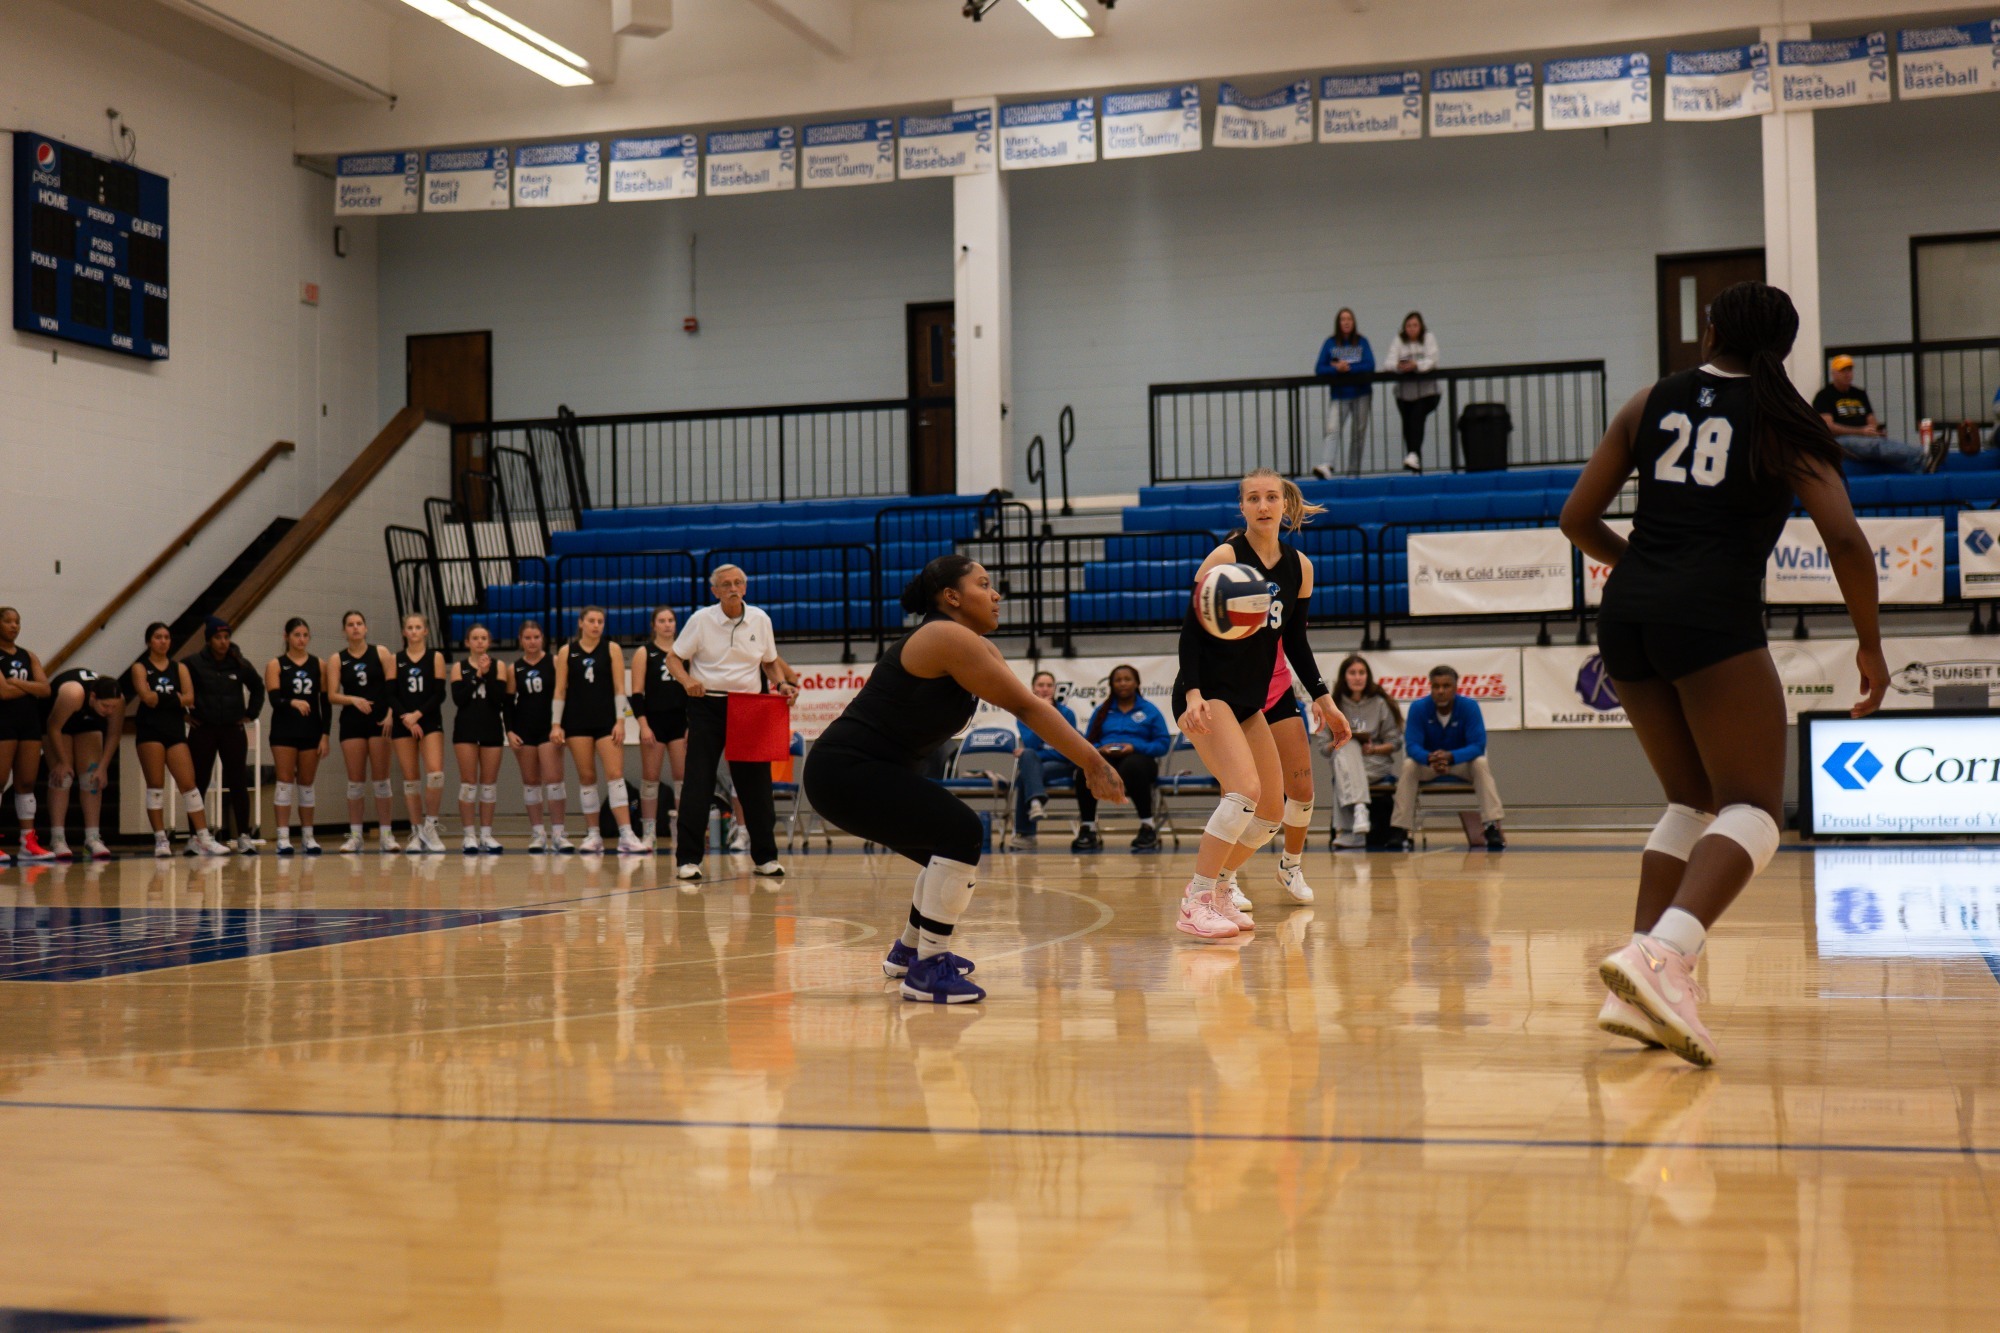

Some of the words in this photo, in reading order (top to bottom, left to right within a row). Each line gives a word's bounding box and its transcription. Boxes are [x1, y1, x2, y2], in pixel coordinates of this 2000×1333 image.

[1866, 32, 1887, 83] 2013
[1630, 52, 1649, 102] 2013
[1750, 42, 1769, 95] 2013
[1903, 62, 1945, 76] Men's
[1441, 69, 1487, 88] SWEET
[1491, 67, 1508, 84] 16
[1514, 62, 1533, 110] 2013
[1783, 75, 1824, 88] Men's
[1903, 67, 1977, 89] Baseball
[1403, 72, 1420, 118] 2013
[1549, 92, 1587, 105] Men's
[1671, 84, 1721, 98] Women's
[1783, 81, 1857, 102] Baseball
[1181, 84, 1198, 131] 2012
[1294, 80, 1311, 126] 2012
[1434, 102, 1472, 113] Men's
[1550, 104, 1579, 119] Track
[1581, 104, 1591, 117] &
[1594, 101, 1621, 117] Field
[1672, 98, 1701, 113] Track
[1704, 98, 1713, 111] &
[1716, 94, 1741, 110] Field
[1077, 97, 1094, 143] 2012
[1221, 113, 1266, 129] Women's
[1324, 109, 1361, 120] Men's
[1434, 109, 1511, 126] Basketball
[976, 109, 992, 154] 2011
[1108, 123, 1144, 135] Men's
[1221, 125, 1248, 140] Track
[1250, 127, 1260, 140] &
[1262, 124, 1286, 139] Field
[1324, 115, 1398, 133] Basketball
[877, 119, 893, 163] 2011
[1005, 135, 1040, 147] Men's
[1108, 135, 1137, 149] Cross
[1138, 131, 1181, 148] Country
[681, 133, 697, 179] 2010
[779, 126, 795, 172] 2010
[904, 145, 939, 158] Men's
[1004, 142, 1067, 160] Baseball
[585, 141, 600, 184] 2006
[807, 152, 849, 165] Women's
[903, 152, 965, 170] Baseball
[404, 152, 418, 196] 2003
[493, 147, 508, 190] 2005
[615, 169, 647, 179] Men's
[711, 163, 743, 175] Men's
[807, 164, 834, 180] Cross
[836, 161, 874, 178] Country
[33, 169, 60, 187] pepsi
[430, 179, 460, 190] Men's
[520, 173, 552, 186] Men's
[615, 177, 672, 193] Baseball
[710, 170, 770, 187] Baseball
[341, 183, 371, 197] Men's
[429, 188, 457, 204] Golf
[519, 183, 548, 199] Golf
[39, 190, 68, 211] HOME
[340, 193, 382, 208] Soccer
[88, 207, 115, 225] PERIOD
[132, 217, 163, 239] GUEST
[92, 237, 113, 253] POSS
[31, 252, 57, 270] FOULS
[89, 250, 116, 268] BONUS
[75, 263, 104, 282] PLAYER
[113, 274, 132, 290] FOUL
[144, 282, 168, 300] FOULS
[40, 317, 59, 332] WON
[111, 334, 133, 349] GAME
[151, 344, 168, 357] WON
[1655, 411, 1733, 487] 28
[1773, 546, 1889, 570] Walt
[1435, 569, 1461, 582] York
[1466, 567, 1493, 580] Cold
[1498, 566, 1545, 581] Storage,
[1548, 566, 1566, 577] LLC
[357, 671, 368, 687] 3
[584, 667, 595, 684] 4
[796, 669, 865, 690] aterin
[1378, 672, 1504, 687] PENR'S
[1932, 666, 1991, 680] SUNSET
[292, 678, 313, 695] 32
[408, 676, 424, 693] 31
[1457, 684, 1507, 698] ROS
[1787, 684, 1834, 695] FARMS
[1552, 713, 1595, 724] KALIFF
[1822, 813, 1871, 828] Proud
[1876, 813, 1959, 832] Supporter
[1965, 812, 1982, 826] of
